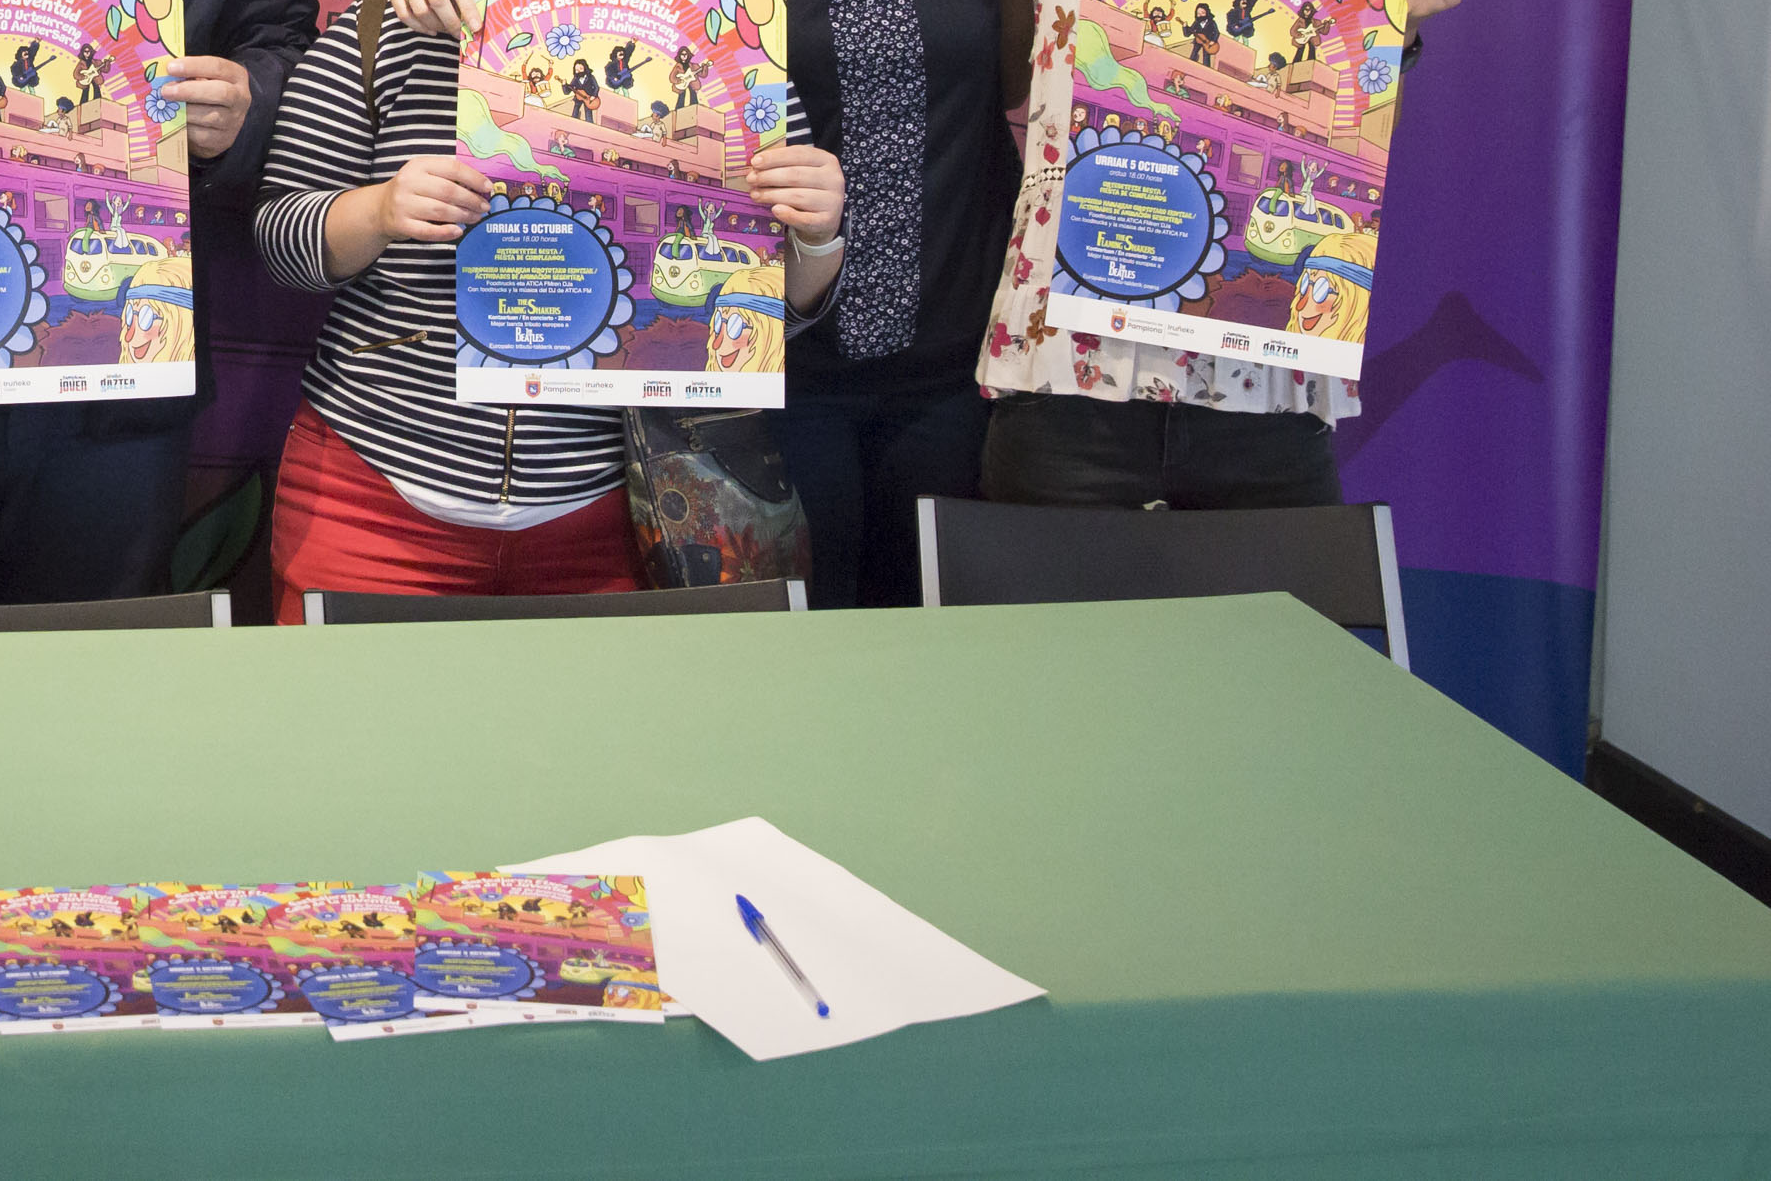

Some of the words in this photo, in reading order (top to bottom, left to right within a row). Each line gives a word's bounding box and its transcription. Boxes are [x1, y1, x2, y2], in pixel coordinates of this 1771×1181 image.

[14, 8, 82, 40] Urteurrena
[511, 0, 551, 21] Casa
[592, 6, 609, 19] 50
[610, 8, 680, 42] Urteurrena
[9, 19, 81, 50] Aniversario
[588, 17, 605, 30] 50
[605, 18, 678, 53] Aniversario
[1094, 154, 1128, 169] URRIAK
[1129, 159, 1136, 170] 5
[1137, 160, 1179, 176] OCTUBRE
[485, 222, 520, 234] URRIAK
[522, 223, 529, 234] 5
[530, 223, 574, 234] OCTUBRE
